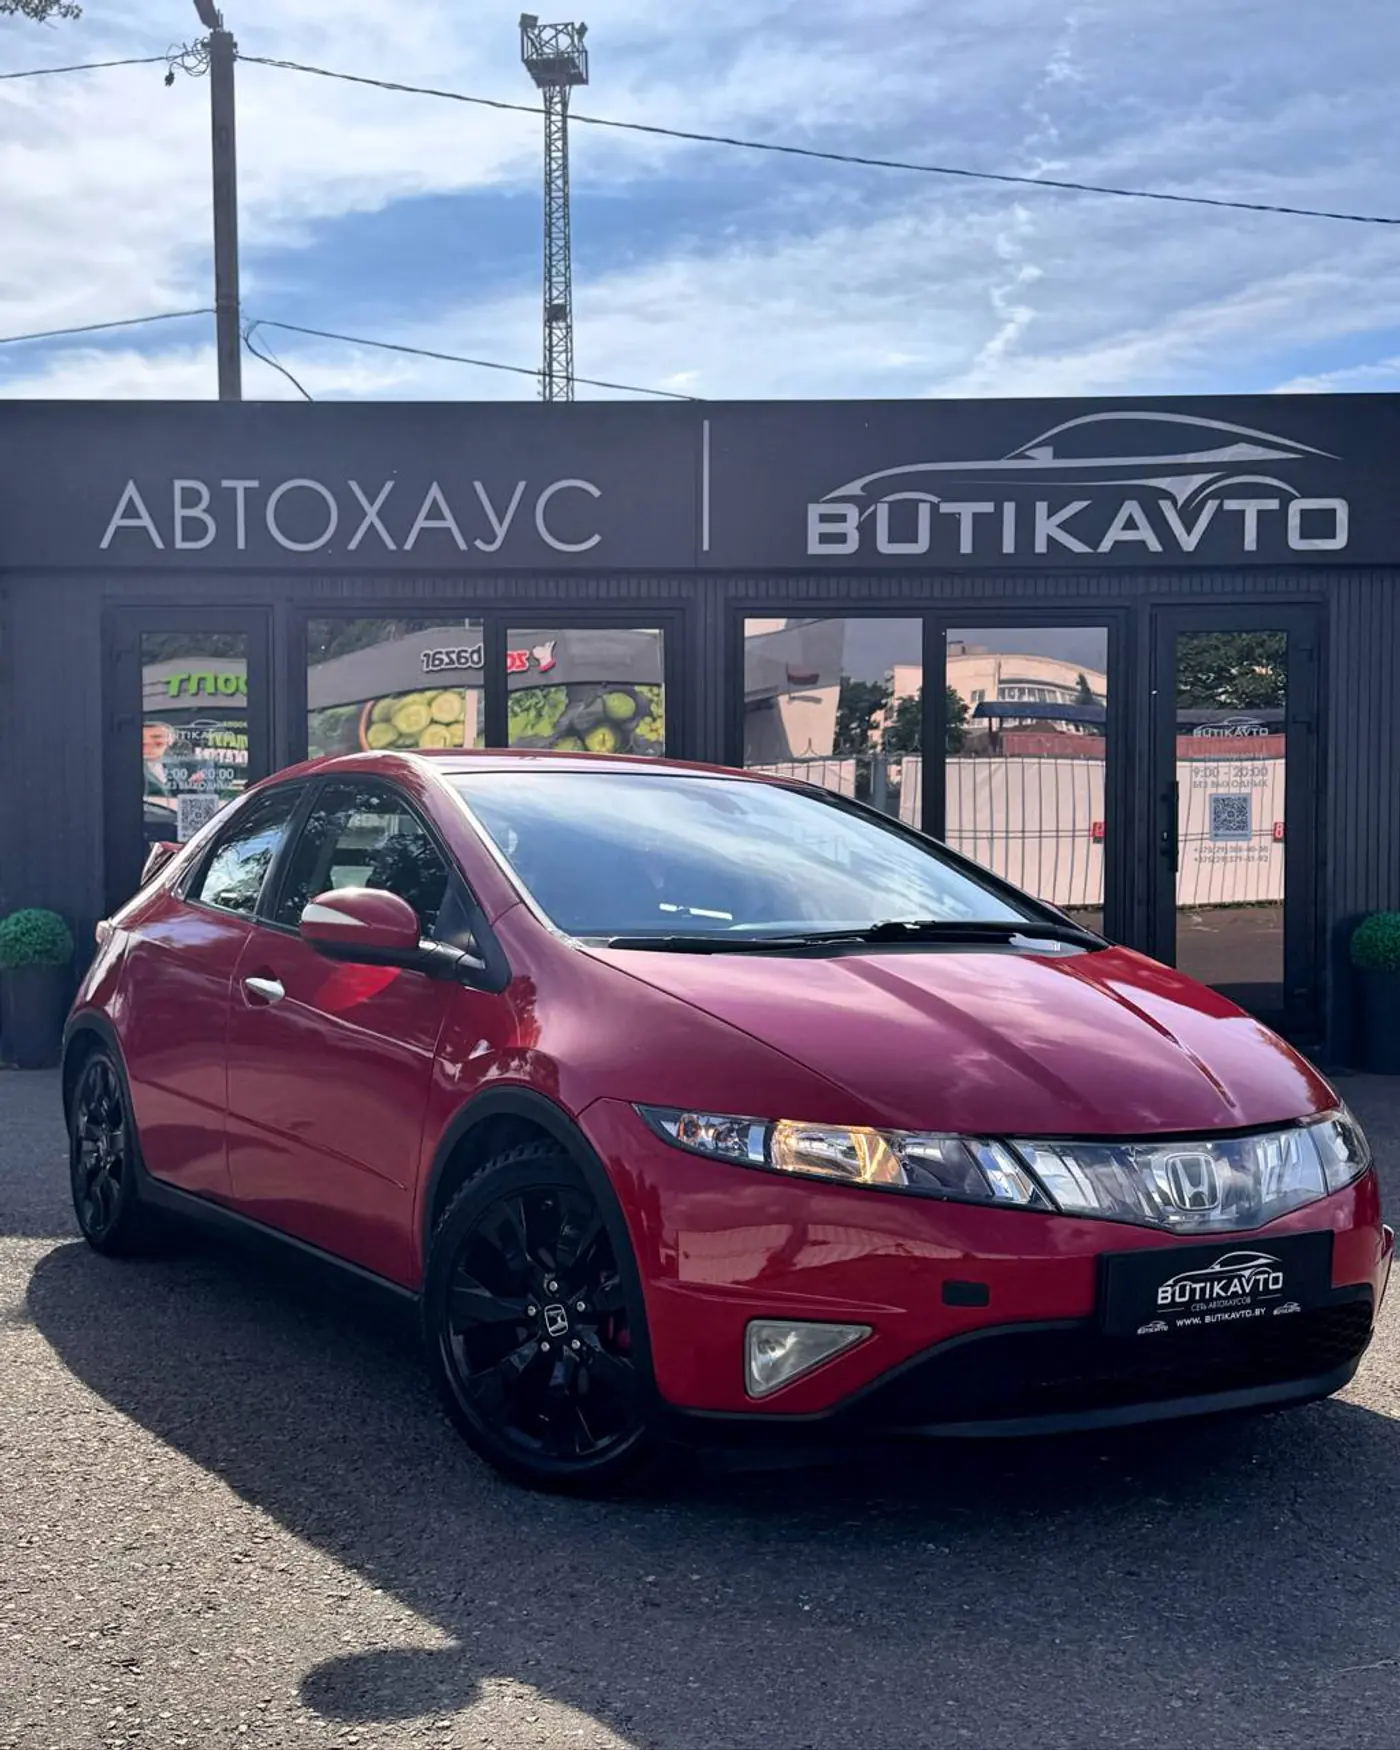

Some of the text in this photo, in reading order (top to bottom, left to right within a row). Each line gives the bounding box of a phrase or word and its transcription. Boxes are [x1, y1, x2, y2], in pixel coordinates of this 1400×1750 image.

[99, 478, 603, 552] АВТОХАУС
[807, 497, 1350, 555] BUTIKAVTO
[1157, 1271, 1284, 1305] BUTIKAVTO
[1204, 1307, 1267, 1324] BUTIKAVTO.BY
